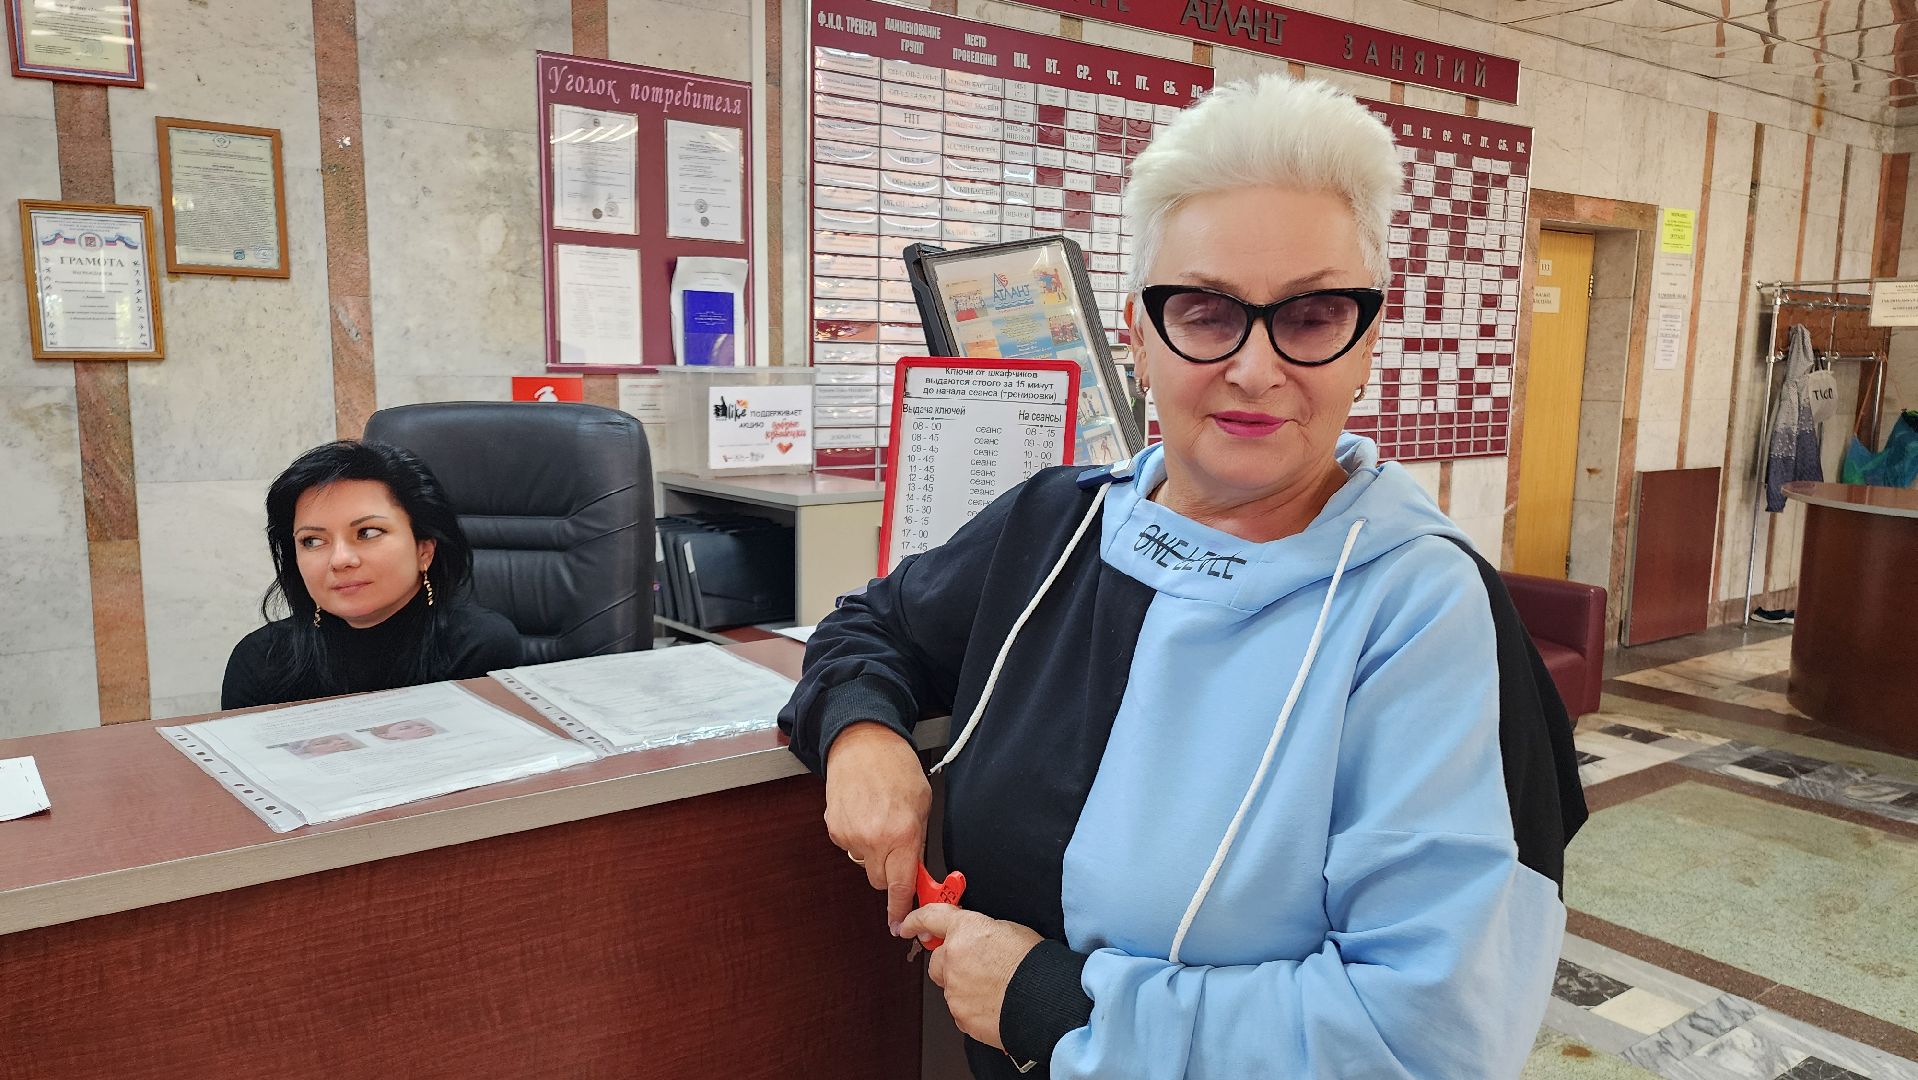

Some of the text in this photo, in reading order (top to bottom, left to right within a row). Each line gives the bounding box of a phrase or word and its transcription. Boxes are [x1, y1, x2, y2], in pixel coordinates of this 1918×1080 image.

[817, 10, 878, 37] Ф.И.О. ТРЕНЕРА
[884, 17, 941, 40] НАИМЕНОВАНИЕ
[964, 33, 987, 48] МЕСТО
[1181, 0, 1487, 88] АТЛАНТ ЗАНЯТИЙ
[900, 38, 925, 55] ГРУПП
[952, 47, 998, 67] ПРОВЕДЕНИЯ
[1013, 51, 1031, 70] ПН.
[1045, 57, 1061, 75] ВТ.
[1076, 64, 1093, 81] СР.
[1106, 69, 1122, 86] ЧТ.
[1135, 74, 1150, 91] ПТ.
[1163, 80, 1179, 96] СБ.
[548, 65, 742, 115] Уголок потребителя
[1402, 123, 1526, 154] ПН. ВТ. СР. ЧТ. ПТ. СБ. ВС.
[60, 256, 125, 267] ГРАМОТА
[945, 367, 974, 376] Ключи
[988, 369, 1038, 379] шкафчиков
[925, 378, 970, 386] выдаются
[972, 379, 1001, 388] строго
[1016, 380, 1025, 388] 15
[1027, 382, 1054, 391] минут
[936, 388, 966, 396] начала
[968, 389, 998, 398] сеанса
[1000, 389, 1057, 402] (тренировки)
[902, 403, 966, 416] Выдача ключей
[1018, 410, 1062, 423] На сеансы
[912, 421, 924, 431] 08
[931, 422, 942, 431] 00
[975, 426, 1003, 435] сеанс
[911, 433, 922, 442] 08
[928, 433, 940, 442] 45
[1025, 427, 1037, 436] 08
[1046, 429, 1056, 438] 15
[973, 437, 1000, 446] сеанс
[1024, 438, 1035, 447] 09
[1042, 440, 1054, 449] 00
[911, 444, 922, 453] 09
[928, 445, 939, 454] 45
[973, 448, 999, 457] сеанс
[907, 454, 916, 463] 10
[922, 455, 935, 464] 45
[1023, 450, 1033, 459] 10
[1040, 451, 1052, 460] 00
[970, 459, 997, 467] сеанс
[1023, 460, 1032, 469] 11
[909, 464, 917, 473] 11
[923, 465, 935, 474] 45
[970, 469, 996, 478] сеанс
[908, 473, 917, 482] 12
[923, 474, 935, 483] 45
[969, 478, 996, 487] сеанс
[907, 482, 916, 492] 13
[922, 483, 934, 493] 45
[969, 488, 995, 496] сеанс
[906, 493, 914, 502] 14
[921, 493, 933, 503] 45
[906, 504, 914, 514] 15
[921, 505, 932, 515] 30
[904, 515, 913, 525] 16
[921, 516, 929, 526] 15
[902, 528, 911, 538] 17
[918, 529, 929, 539] 00
[901, 541, 911, 550] 17
[917, 541, 928, 551] 45
